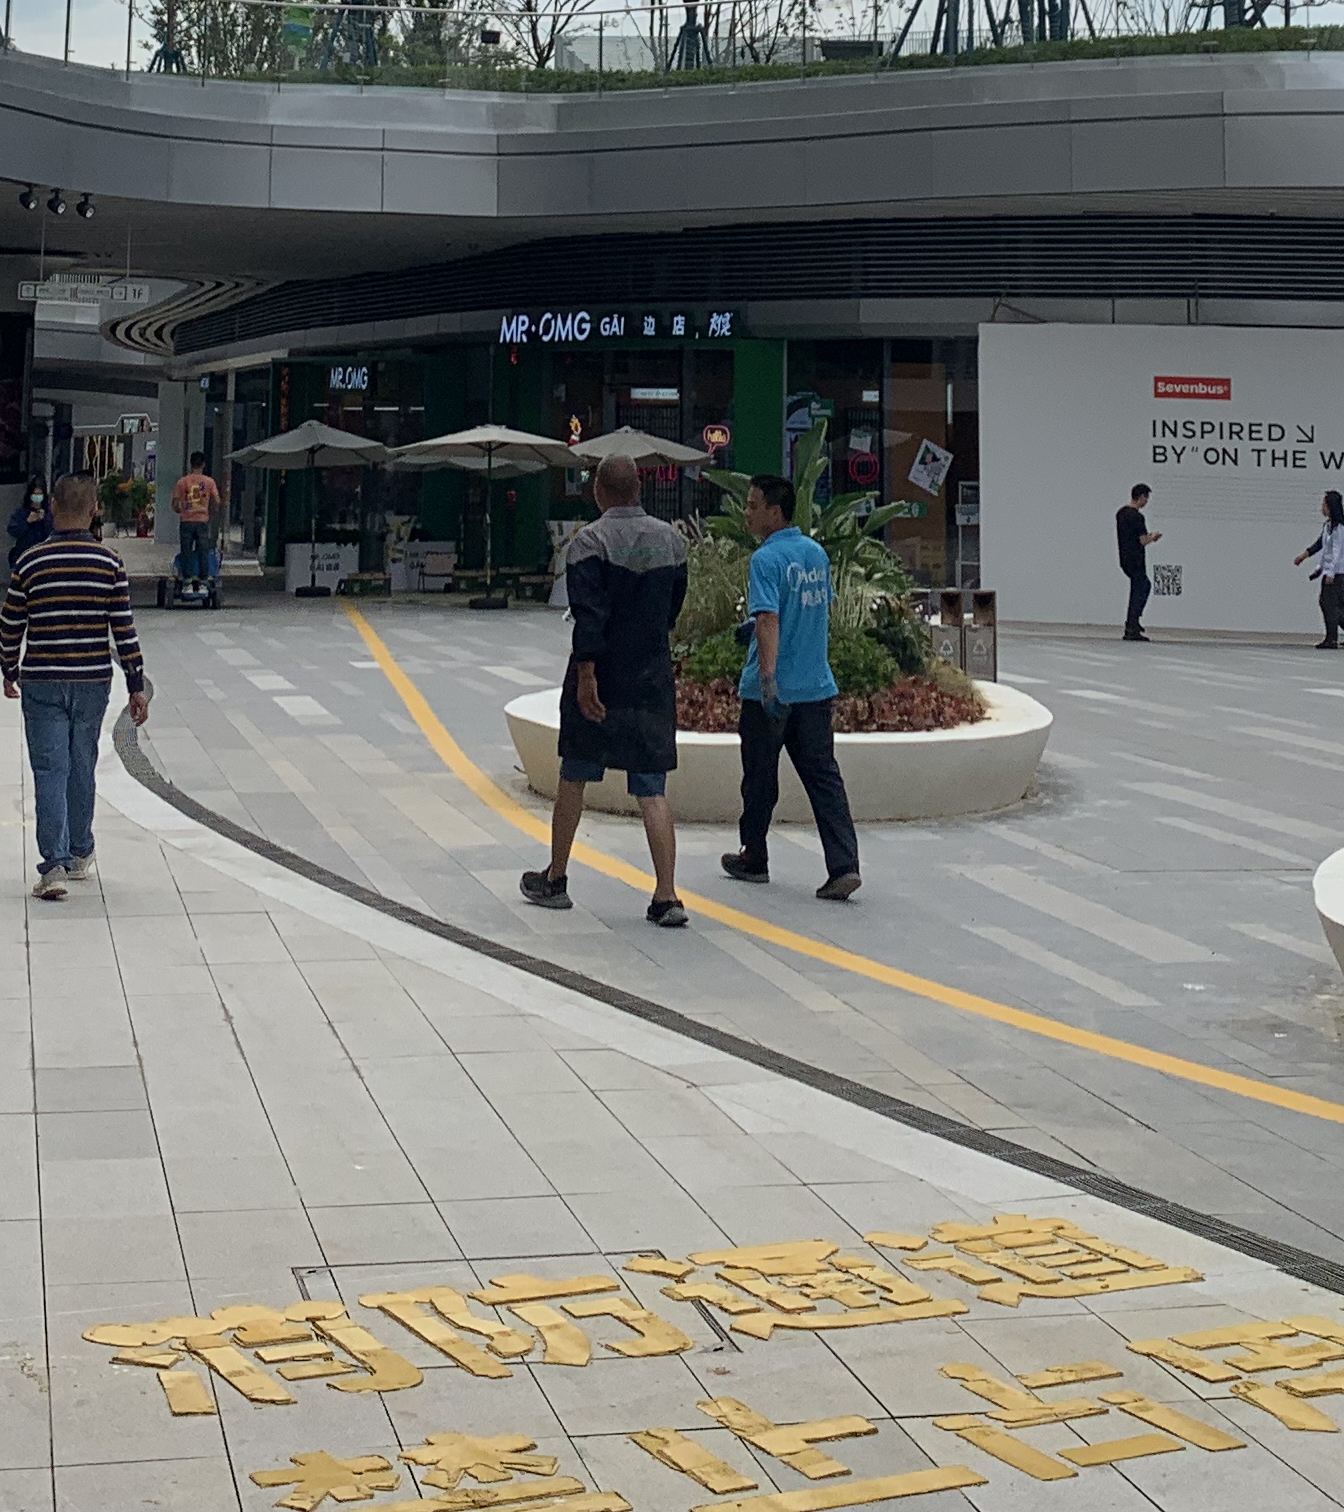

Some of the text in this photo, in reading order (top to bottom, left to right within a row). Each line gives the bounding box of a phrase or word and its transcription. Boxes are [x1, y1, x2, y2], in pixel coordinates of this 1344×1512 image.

[1157, 381, 1224, 395] Sevenbus
[1152, 419, 1286, 442] INSPIRED
[1251, 448, 1307, 468] THE
[82, 1214, 1205, 1416] 消防通道
